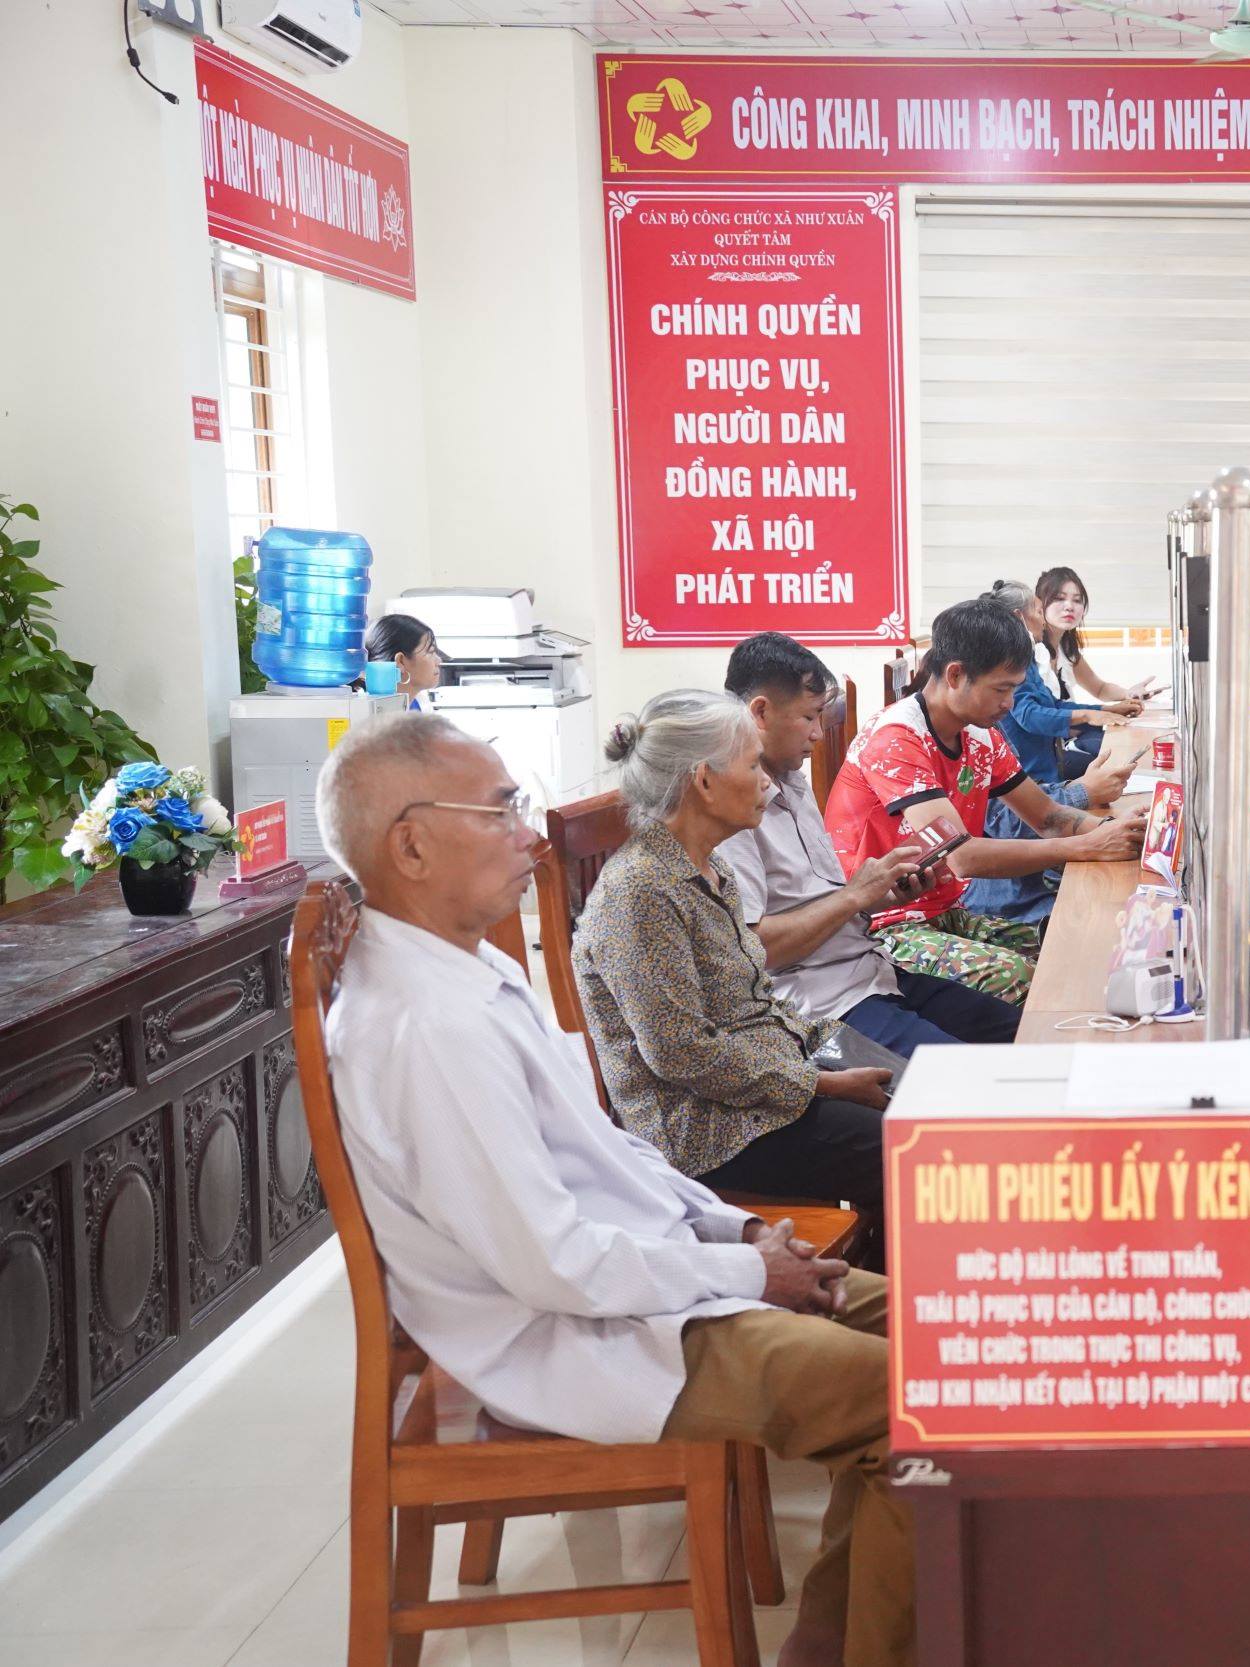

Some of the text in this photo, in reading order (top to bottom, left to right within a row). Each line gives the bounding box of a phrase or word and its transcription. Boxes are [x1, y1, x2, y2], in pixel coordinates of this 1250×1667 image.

[732, 86, 807, 149] CÔNG
[816, 99, 888, 156] KHAI,
[897, 99, 970, 150] MINH
[979, 99, 1059, 162] BẠCH,
[1068, 88, 1155, 150] TRÁCH
[200, 84, 380, 242] ỘT NGÀY PHỤC VỤ NHÂN DÂN TỐT HƠN
[671, 210, 689, 227] BỘ
[693, 210, 730, 224] CÔNG
[734, 210, 771, 224] CHỨC
[795, 212, 825, 224] NHƯ
[827, 210, 864, 225] XUÂN
[714, 229, 791, 247] QUYẾT TÂM
[671, 249, 835, 268] XÂY DỰNG CHÍNH QUYỀN
[651, 294, 860, 339] CHÍNH QUYỀN
[687, 359, 829, 396] PHỤC VỤ,
[675, 406, 845, 443] NGƯỜI DÂN
[665, 457, 856, 500] ĐỒNG HÀNH,
[712, 514, 814, 557] XÃ HỘI
[676, 561, 853, 603] PHÁT TRIỂN
[914, 1149, 989, 1223] HÒM
[998, 1144, 1093, 1222] PHIẾU
[1102, 1142, 1160, 1220] LẤY
[1169, 1150, 1189, 1219] Ý
